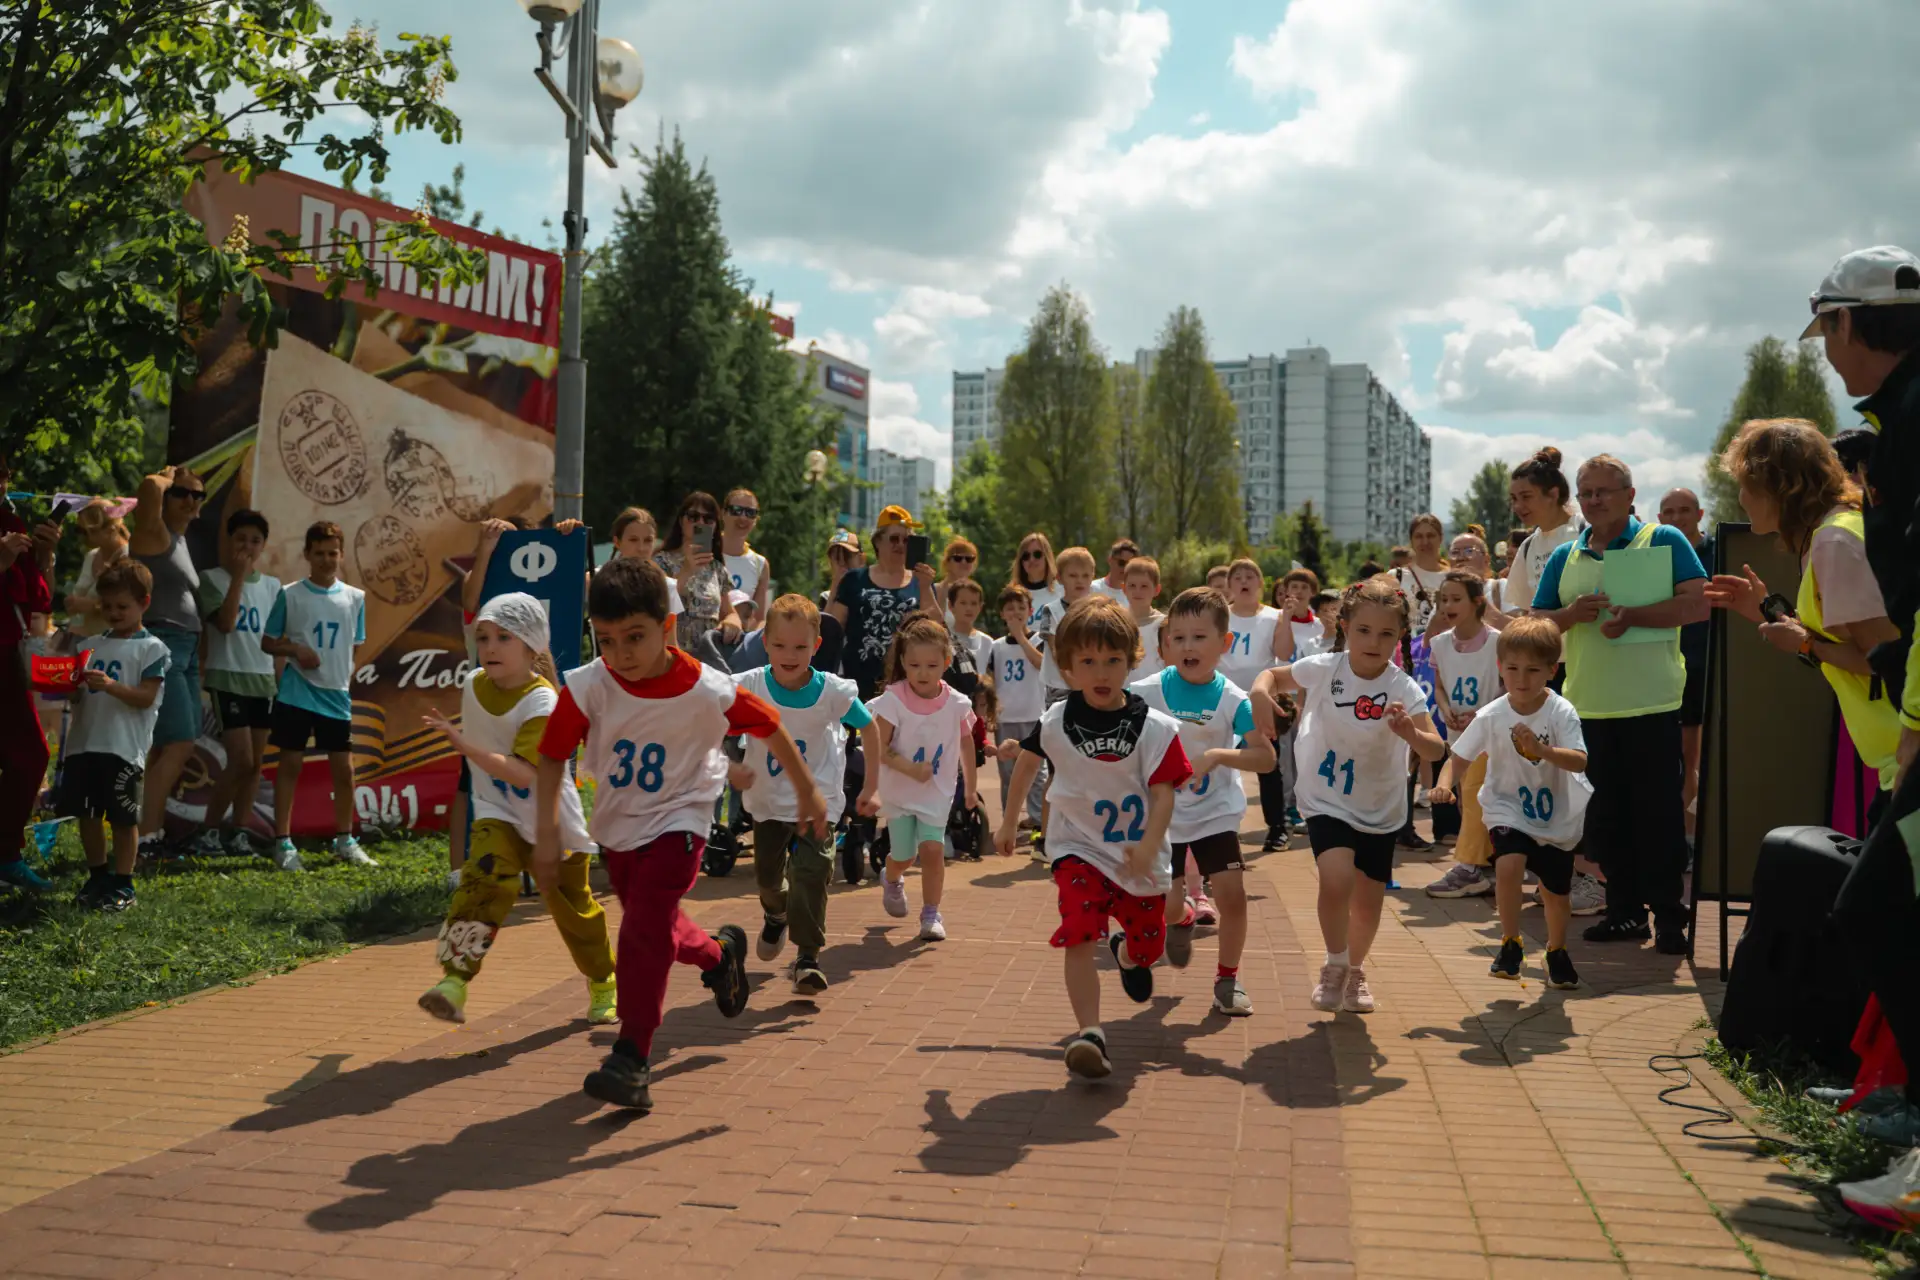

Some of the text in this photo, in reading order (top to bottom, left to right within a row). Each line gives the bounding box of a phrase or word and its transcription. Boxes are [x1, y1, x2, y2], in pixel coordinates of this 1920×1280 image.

[236, 604, 260, 633] 20
[313, 620, 339, 649] 17
[1004, 659, 1025, 682] 33
[1451, 676, 1479, 706] 43
[608, 739, 666, 793] 38
[1317, 749, 1355, 795] 41
[330, 784, 418, 829] 941
[1094, 794, 1145, 843] 22
[1518, 785, 1554, 822] 30
